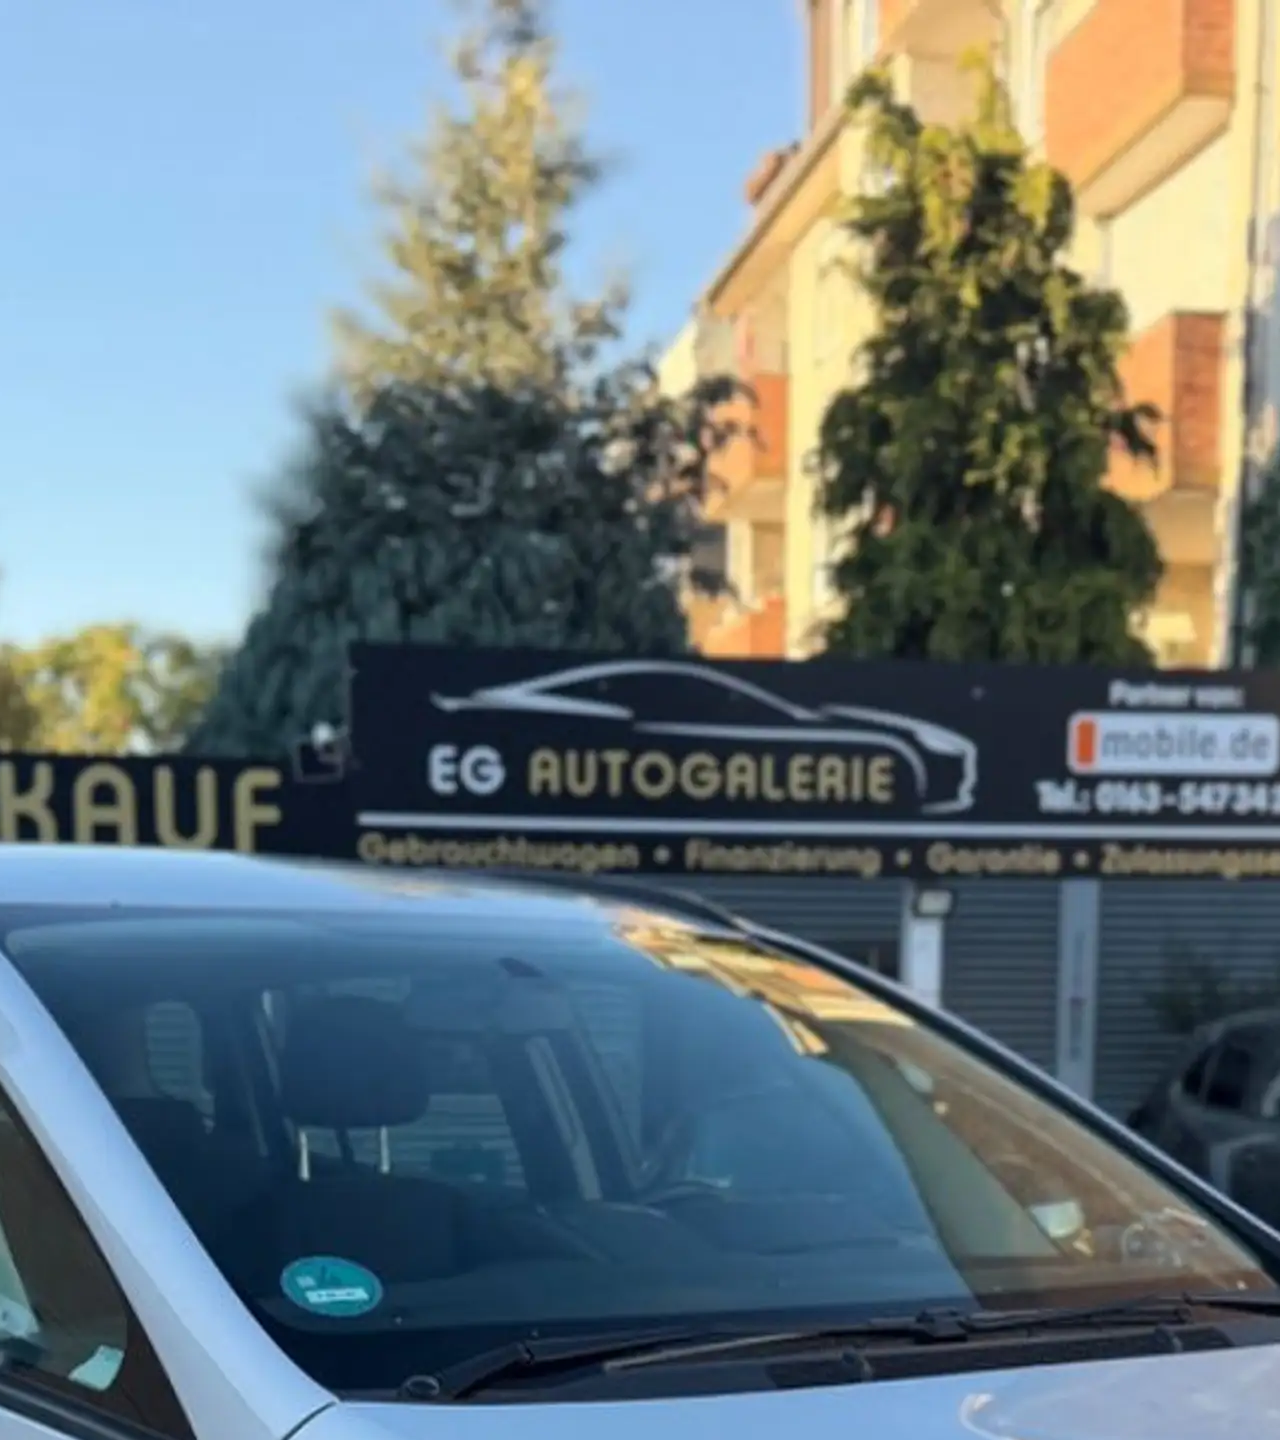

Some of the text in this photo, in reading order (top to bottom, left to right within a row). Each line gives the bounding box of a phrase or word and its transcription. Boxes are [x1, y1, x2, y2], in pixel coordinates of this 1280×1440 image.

[1102, 728, 1272, 760] mobile.de
[428, 746, 894, 802] EG AUTOGALERIE
[685, 839, 882, 877] Finanzierung
[927, 842, 1060, 876] Garantie
